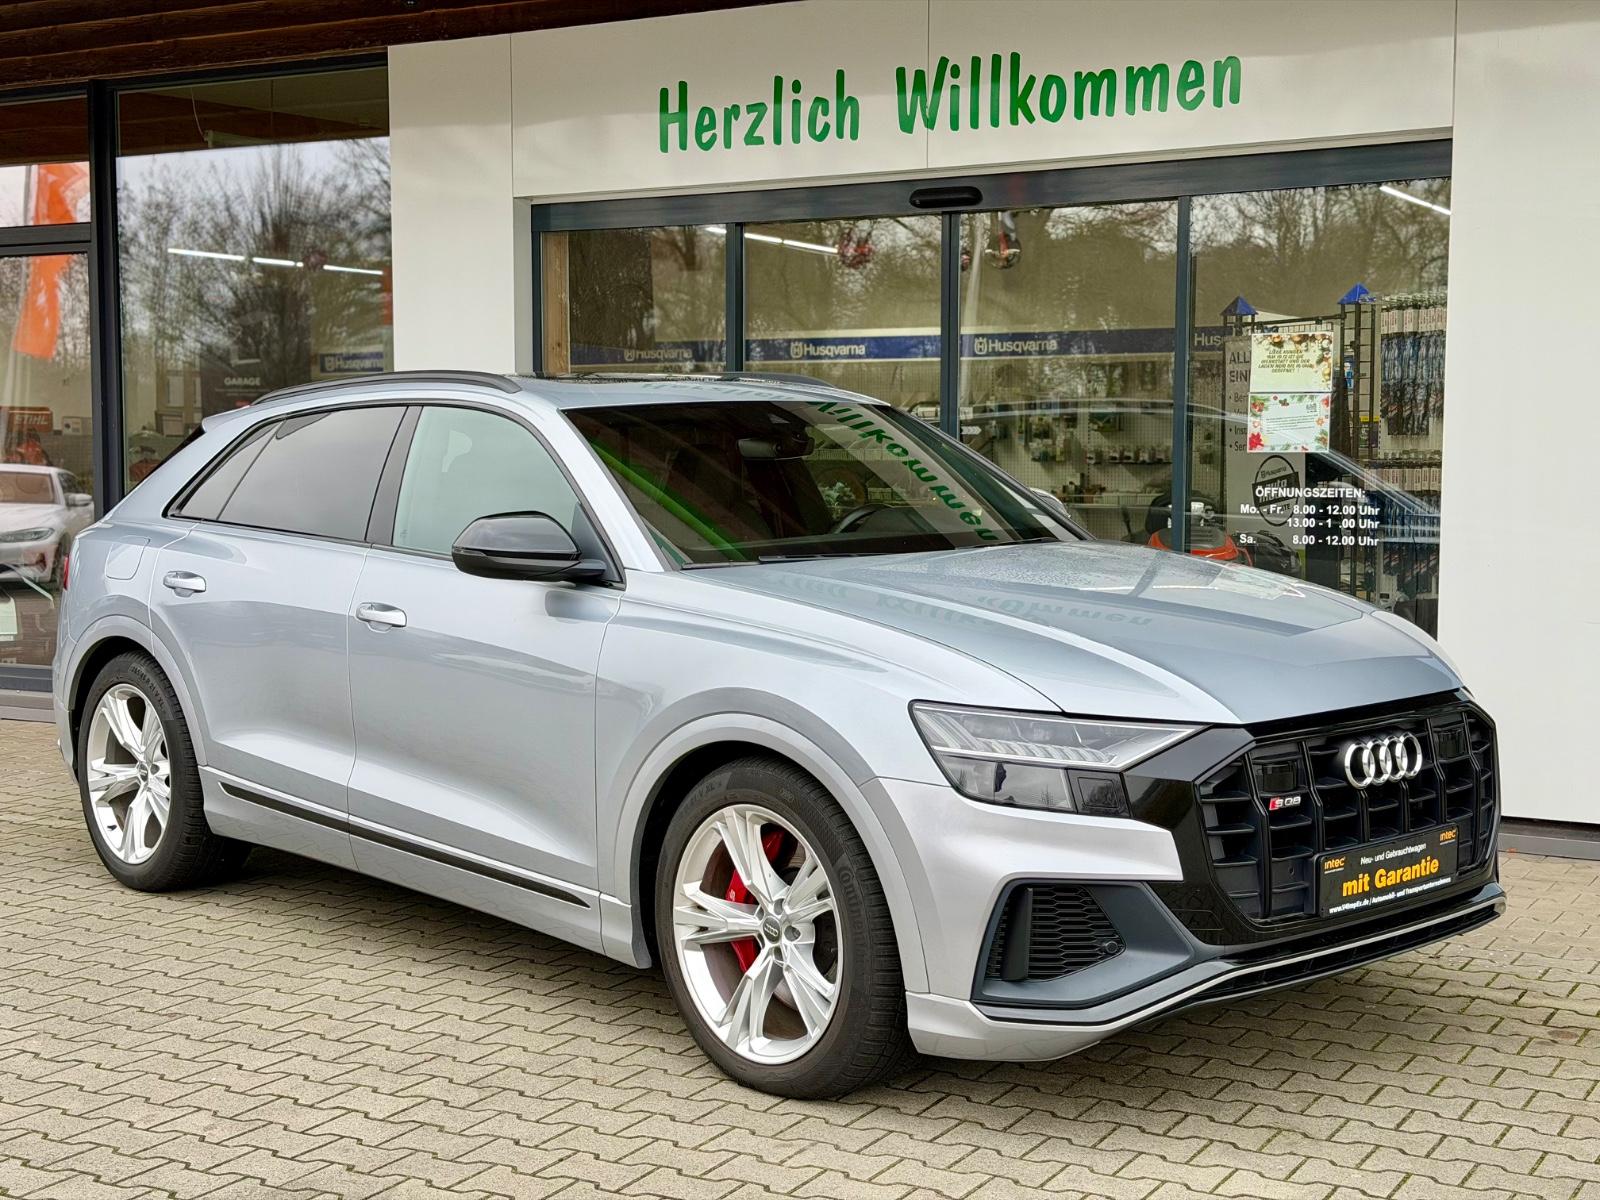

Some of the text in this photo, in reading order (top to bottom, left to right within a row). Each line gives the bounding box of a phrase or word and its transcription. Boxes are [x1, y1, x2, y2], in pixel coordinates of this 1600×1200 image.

[659, 51, 1242, 153] Herzlich Willkommen
[803, 343, 866, 357] Husqvarna
[988, 339, 1058, 354] Husqvarna
[636, 348, 693, 361] Husqvarna
[224, 377, 261, 386] GARAGE
[15, 413, 49, 425] STIHL
[1255, 487, 1366, 498] ÖFFNUNGSZEITEN:
[1240, 504, 1260, 514] Mo.
[1270, 504, 1284, 514] Fr.
[1293, 505, 1316, 515] 8.00
[1326, 505, 1356, 515] 12.00
[1358, 506, 1380, 516] Uhr
[1287, 518, 1316, 528] 13.00
[1358, 519, 1380, 529] Uhr
[1239, 534, 1257, 544] Sa.
[1292, 535, 1315, 545] 8.00
[1325, 535, 1356, 546] 12.00
[1358, 536, 1380, 546] Uhr
[1273, 796, 1301, 808] SQ8
[1360, 843, 1427, 866] Neu- und Gebrauchtwagen
[1324, 857, 1345, 870] intec
[1342, 856, 1440, 897] mit Garantie
